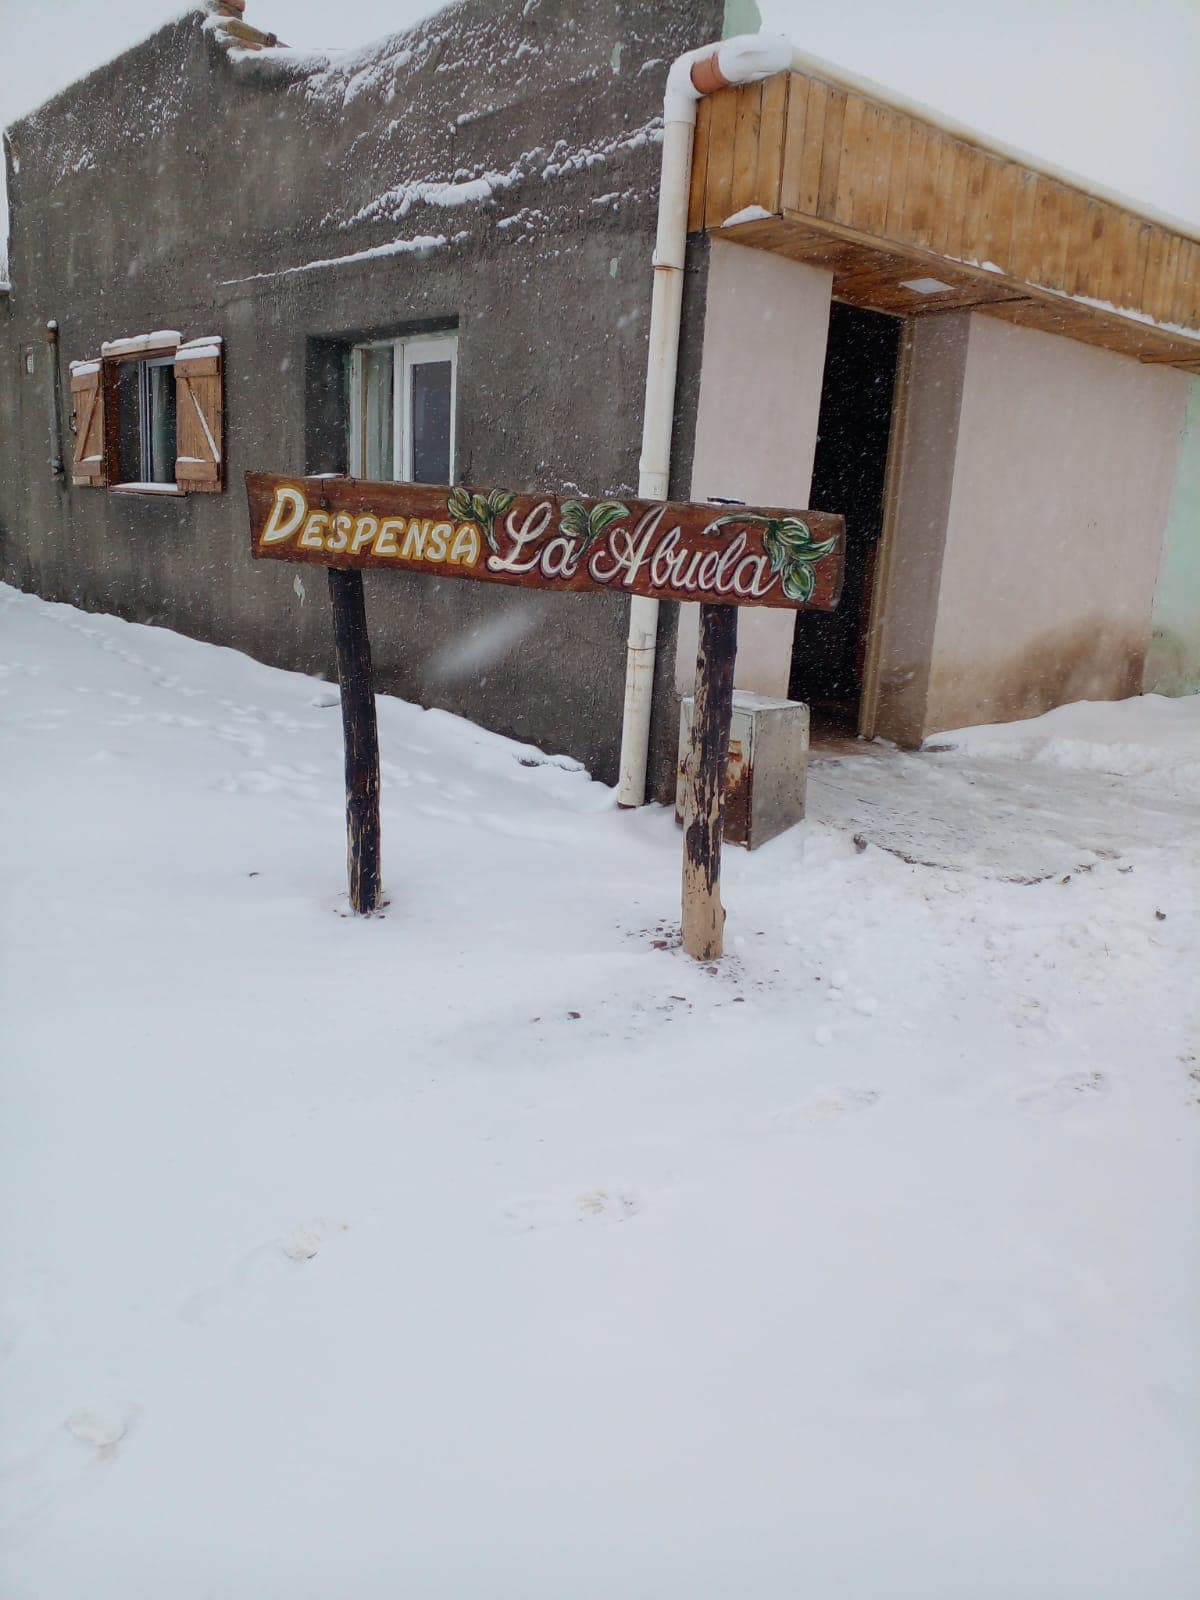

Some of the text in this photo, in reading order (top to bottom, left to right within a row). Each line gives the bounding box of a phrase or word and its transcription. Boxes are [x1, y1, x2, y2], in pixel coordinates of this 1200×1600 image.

[260, 484, 778, 597] DESPENSA La Abuela
